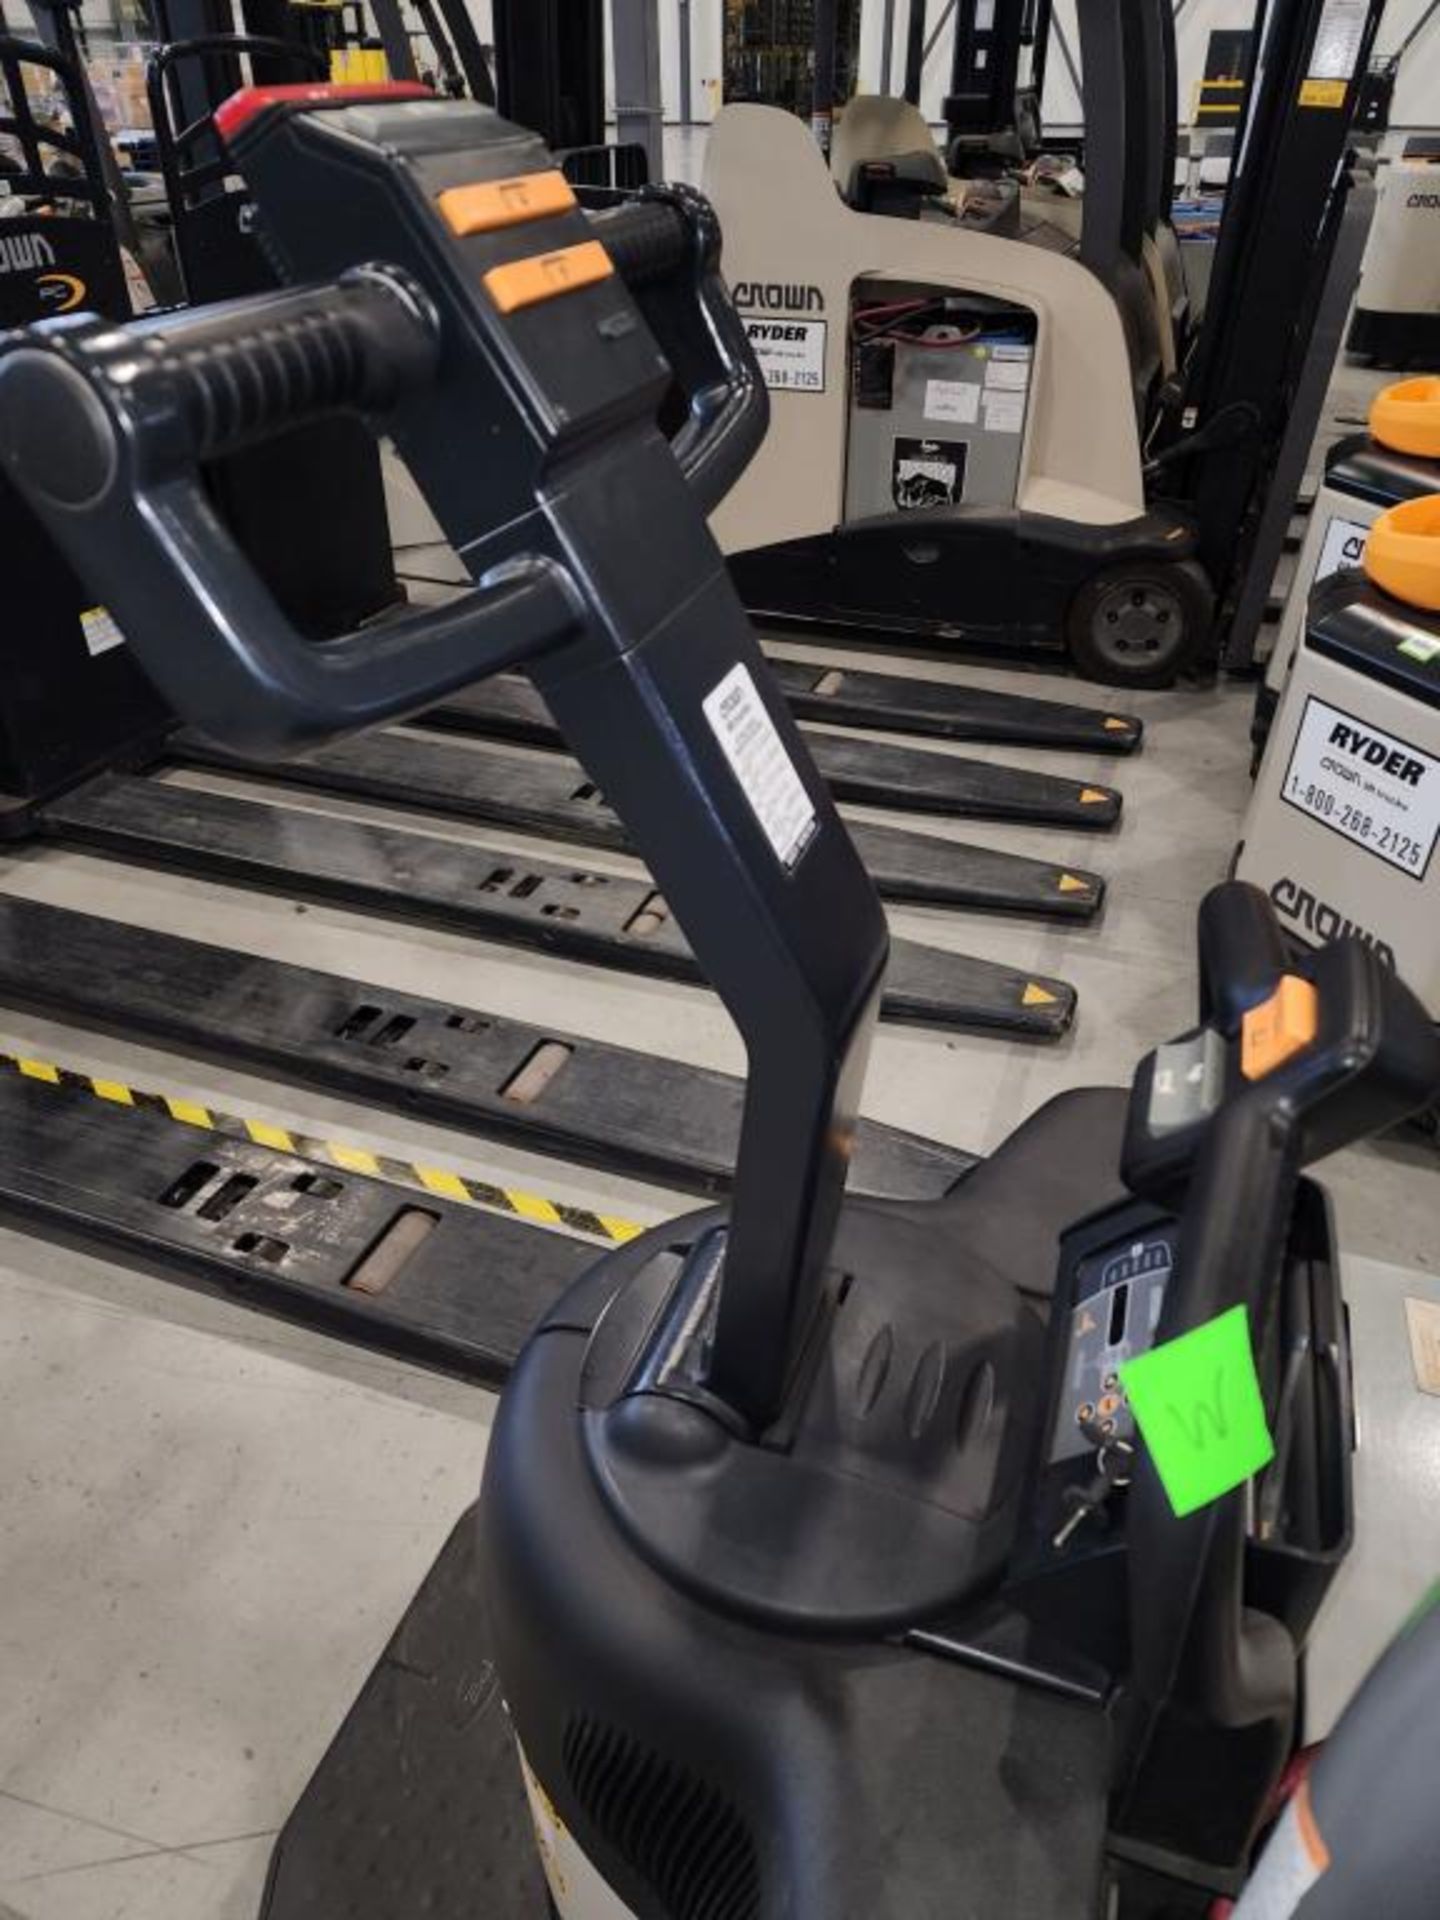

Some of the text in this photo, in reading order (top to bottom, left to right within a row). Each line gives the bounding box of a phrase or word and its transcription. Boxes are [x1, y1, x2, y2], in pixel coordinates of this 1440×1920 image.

[1406, 193, 1440, 208] CRO
[732, 283, 824, 311] CROWN
[747, 324, 808, 342] RYDER
[1329, 722, 1426, 787] RYDER
[1292, 776, 1422, 866] 1-800-268-2125
